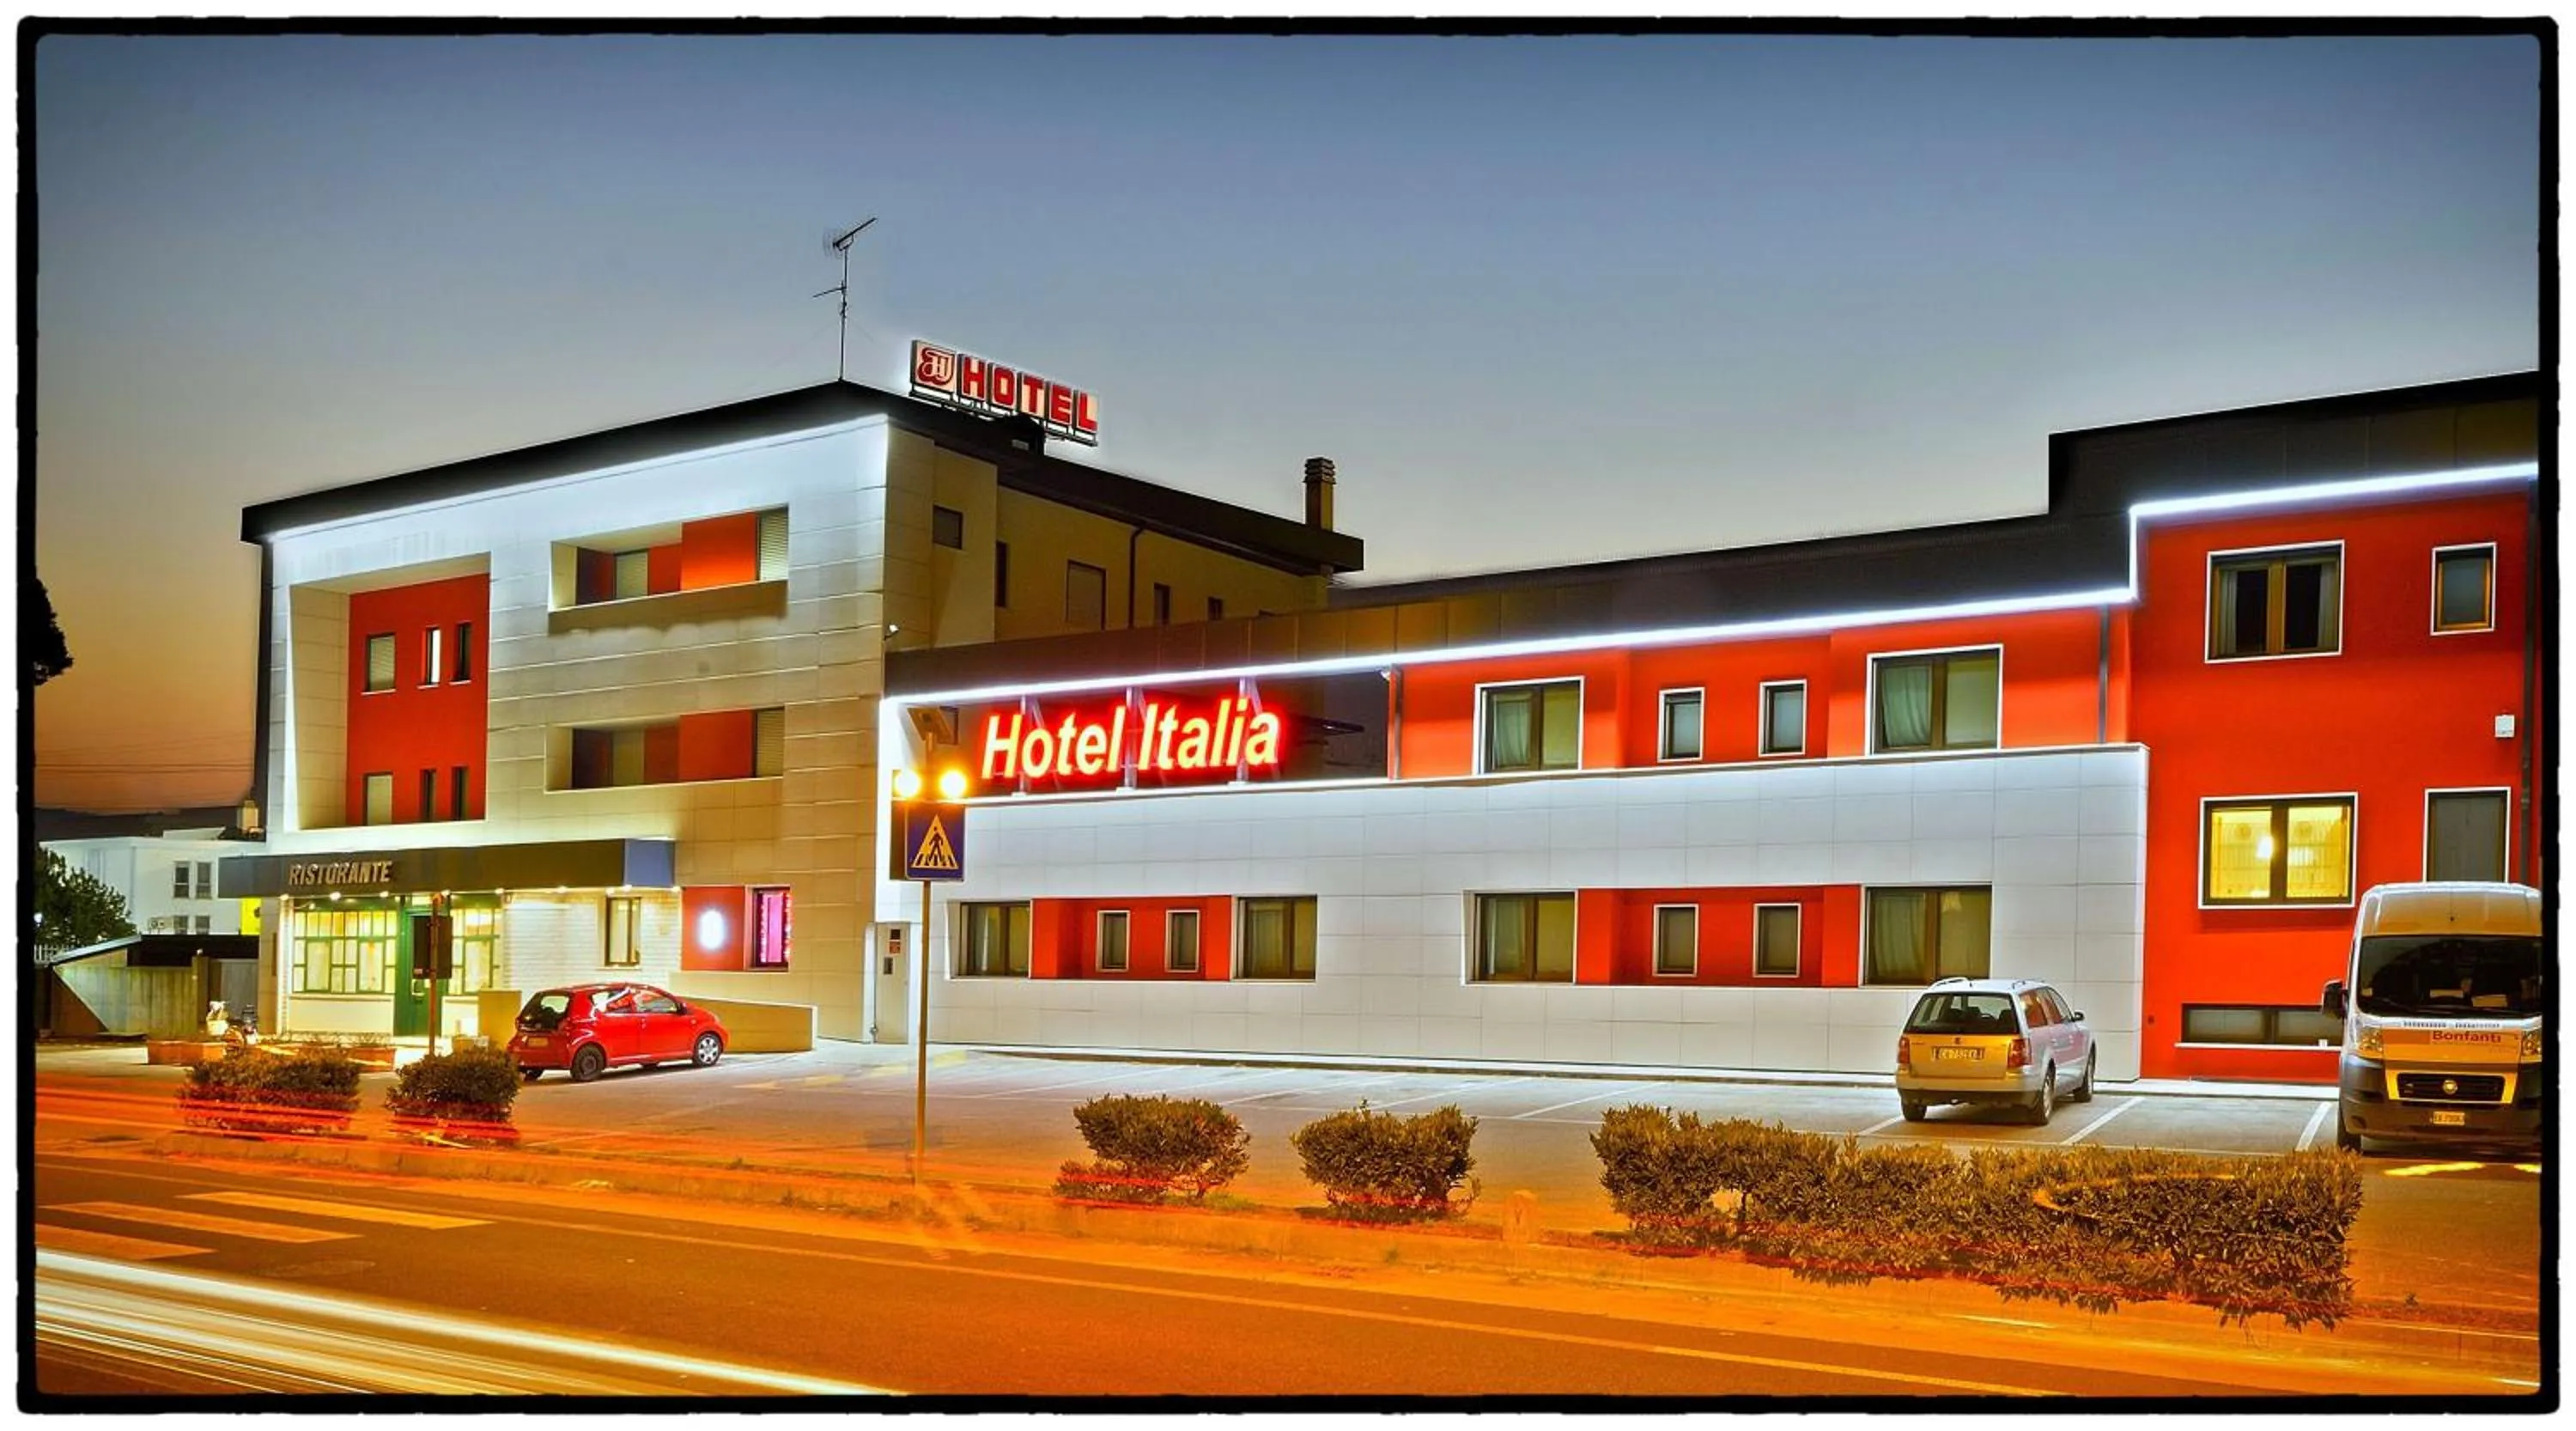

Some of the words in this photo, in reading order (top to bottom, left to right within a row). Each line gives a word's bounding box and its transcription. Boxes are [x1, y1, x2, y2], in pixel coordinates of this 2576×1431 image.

[962, 356, 1098, 433] HOTEL
[981, 705, 1127, 780] Hotel
[1137, 697, 1280, 771] Italia
[289, 861, 392, 886] RISTORANTE
[2432, 1030, 2501, 1044] Bonfanti
